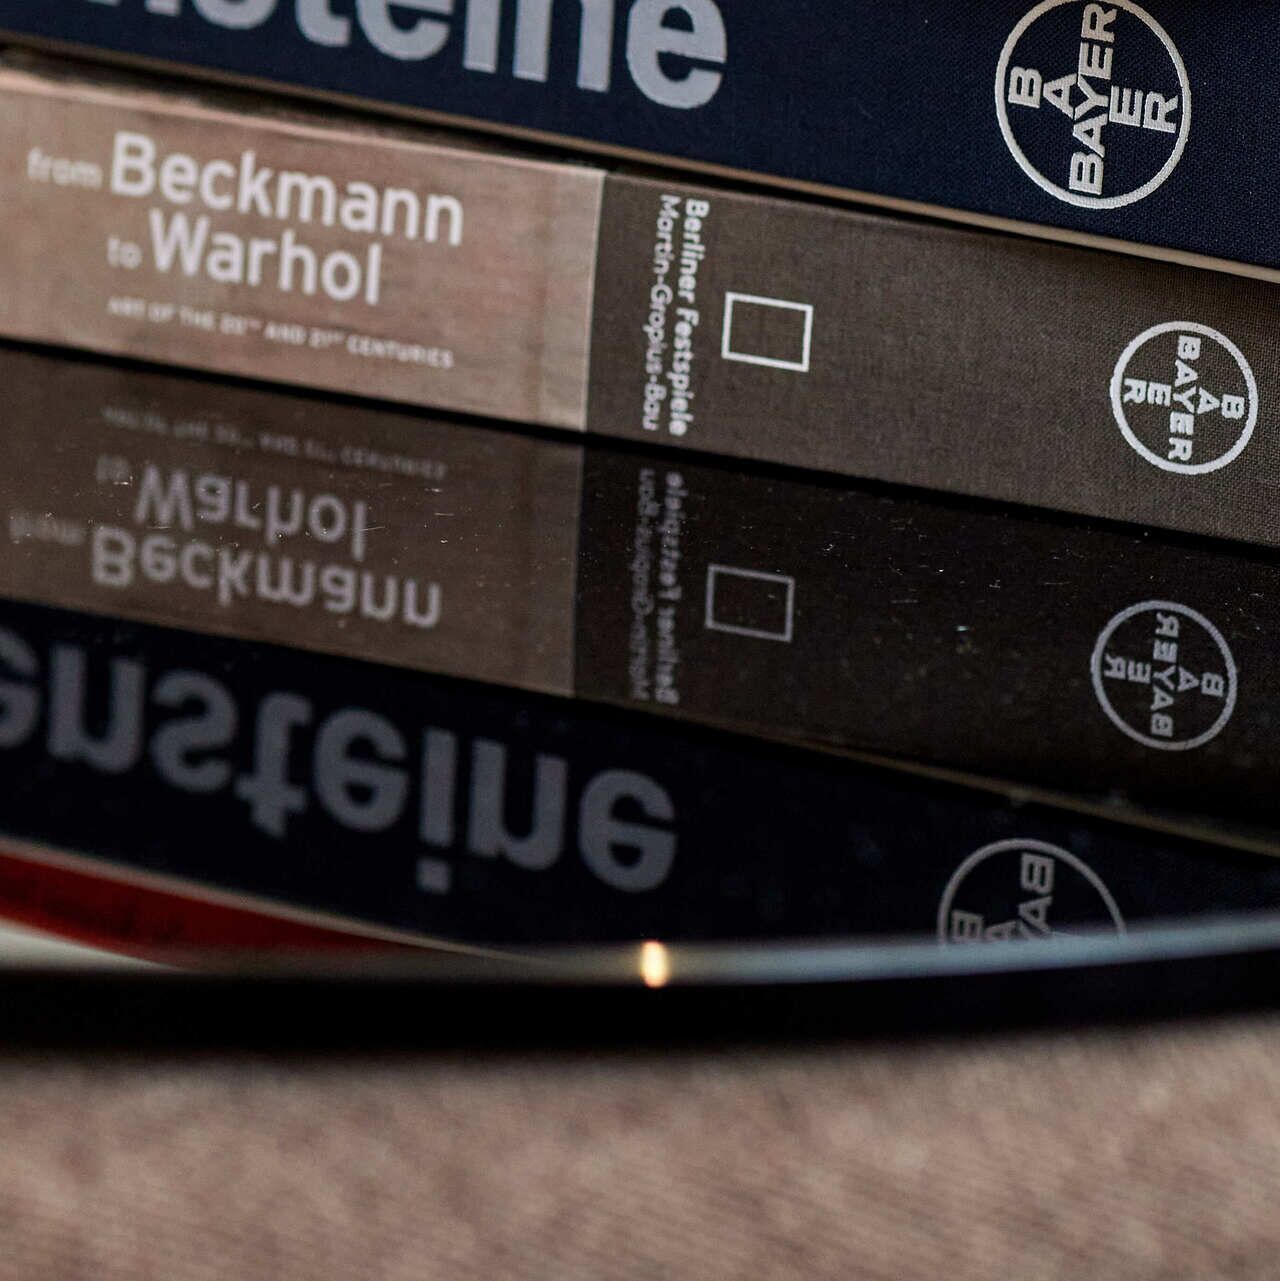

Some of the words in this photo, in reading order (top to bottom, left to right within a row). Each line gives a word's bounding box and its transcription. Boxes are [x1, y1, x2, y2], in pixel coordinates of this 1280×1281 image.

[1008, 66, 1179, 134] BAYER
[1069, 3, 1117, 196] BAYER
[27, 146, 102, 190] from
[110, 130, 464, 246] Beckmann
[106, 235, 142, 270] to
[149, 208, 383, 306] Warhol
[677, 198, 710, 304] Berliner
[642, 194, 681, 431] Martin-Gropius-Bau
[667, 307, 700, 437] Festspiele
[1123, 378, 1245, 420] BAYER
[1168, 335, 1201, 461] BAYER
